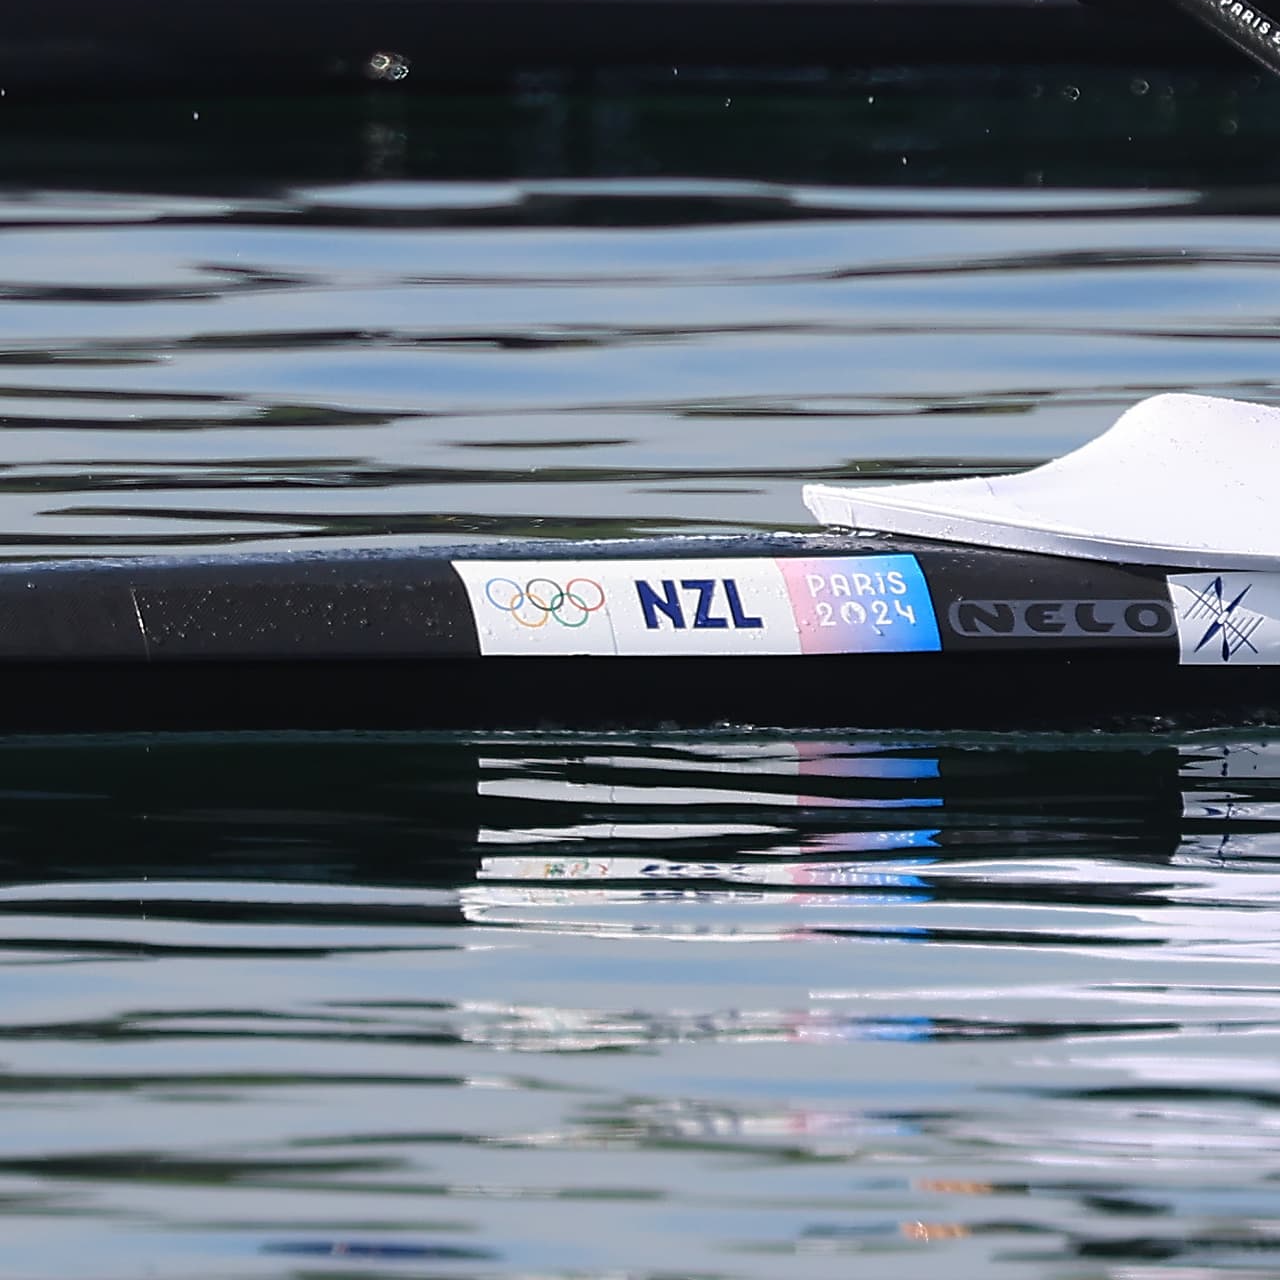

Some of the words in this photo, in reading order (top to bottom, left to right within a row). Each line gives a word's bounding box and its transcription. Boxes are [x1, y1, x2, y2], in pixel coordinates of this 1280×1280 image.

[807, 570, 907, 597] PARIS
[635, 579, 763, 630] NZL
[816, 600, 916, 627] 2024
[958, 603, 1171, 634] NELO
